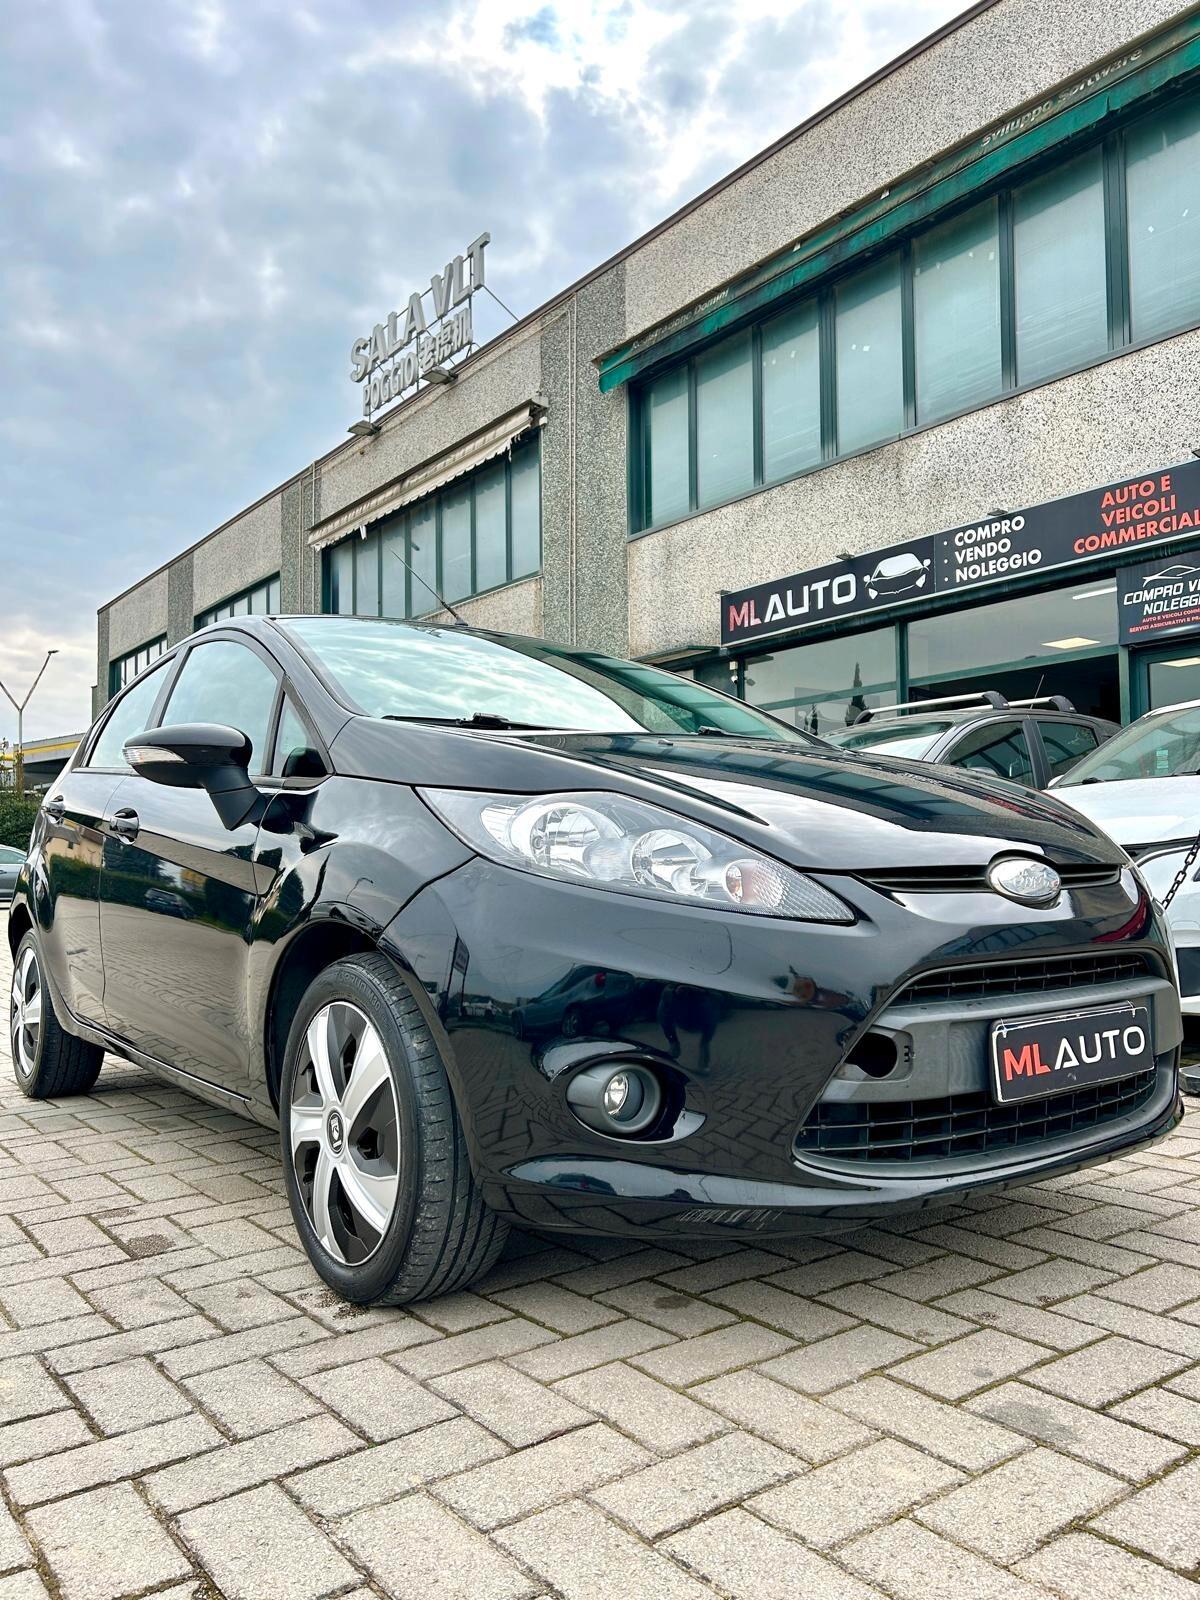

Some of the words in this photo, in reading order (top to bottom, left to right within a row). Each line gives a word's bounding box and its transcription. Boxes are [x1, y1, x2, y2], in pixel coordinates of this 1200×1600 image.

[350, 292, 426, 383] SALA
[430, 232, 491, 319] VLT
[418, 307, 473, 373] 老虎机
[363, 351, 419, 416] POGGIO
[1101, 480, 1155, 508] AUTO
[1161, 475, 1171, 491] E
[1101, 495, 1177, 527] VEICOLI
[954, 515, 1025, 547] COMPRO
[1073, 509, 1200, 554] COMMERCIAL
[954, 538, 1012, 565] VENDO
[955, 549, 1042, 583] NOLEGGIO
[729, 599, 762, 632] ML
[764, 573, 857, 623] AUTO
[1123, 582, 1184, 606] COMPRO
[1150, 618, 1186, 629] ASSICURATIVI
[1161, 611, 1183, 620] VEICOLI
[1003, 1043, 1051, 1081] ML
[1054, 1025, 1146, 1070] AUTO
